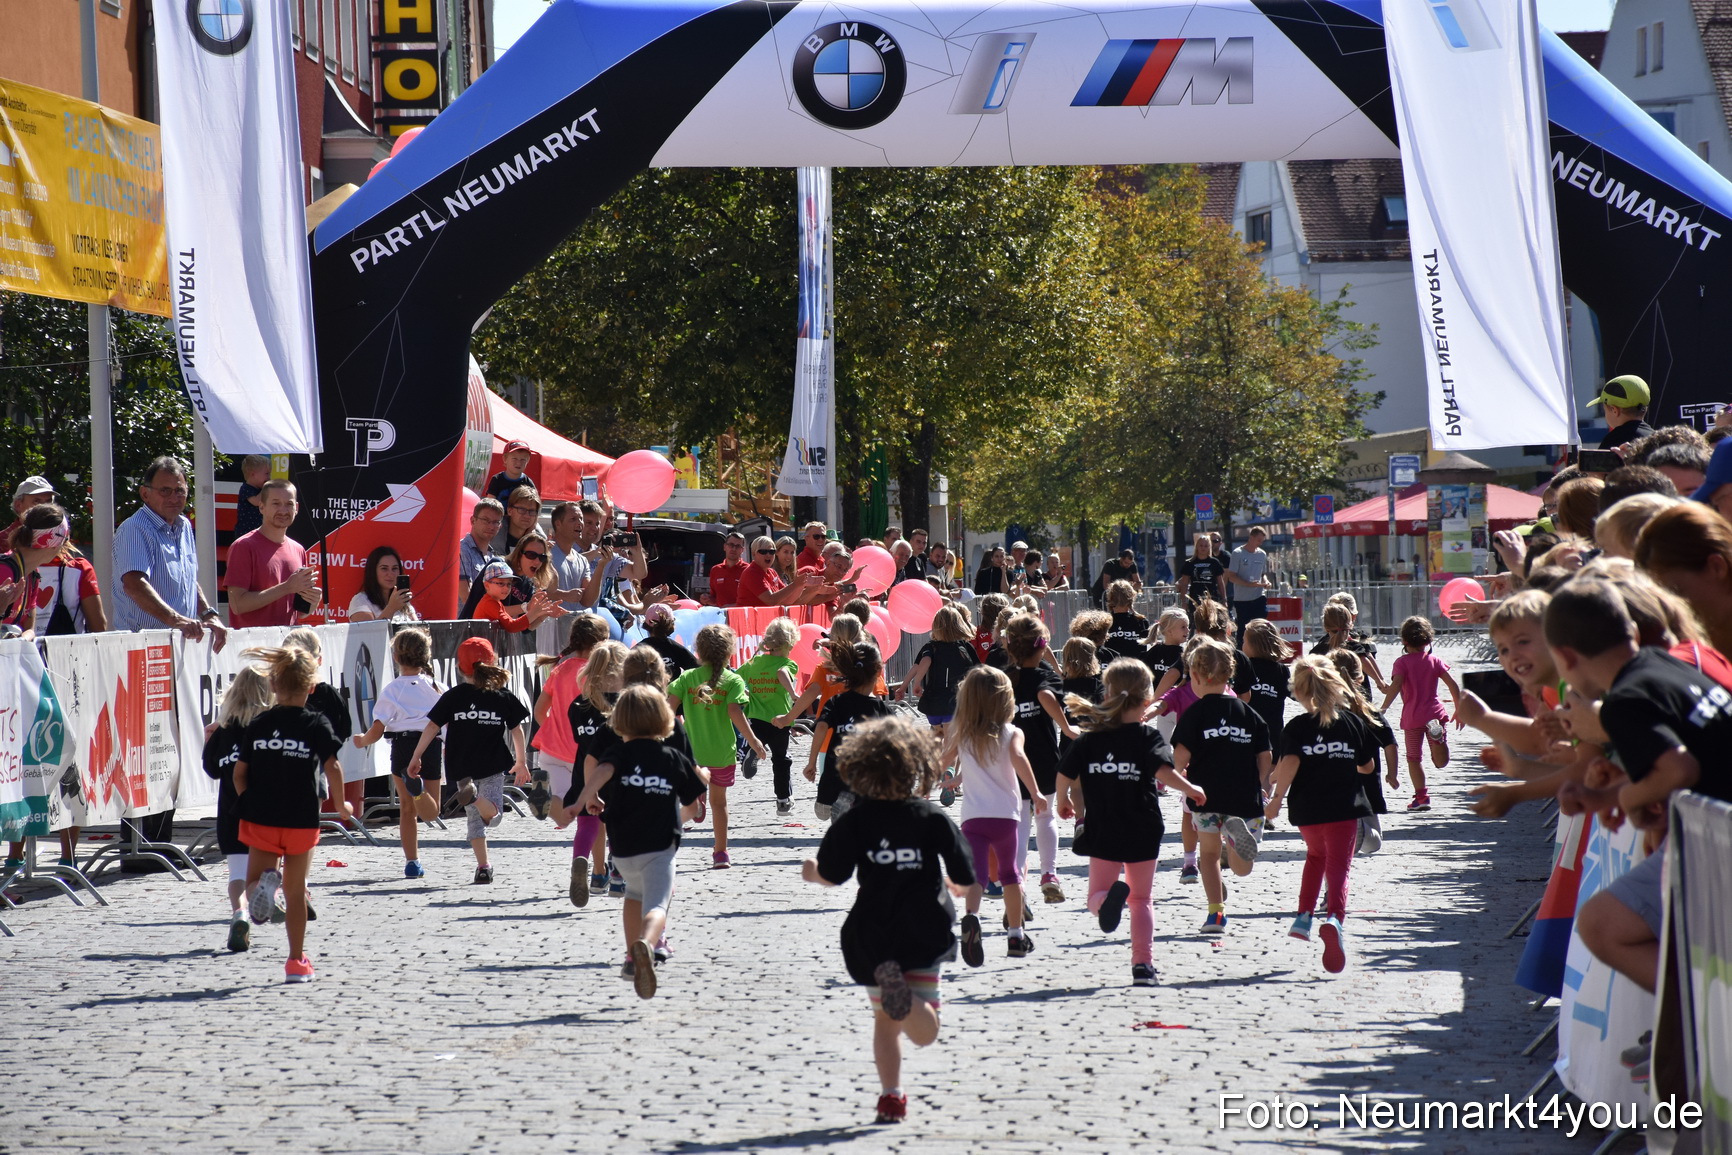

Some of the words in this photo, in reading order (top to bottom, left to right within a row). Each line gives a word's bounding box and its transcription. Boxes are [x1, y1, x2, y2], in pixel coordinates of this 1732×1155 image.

[803, 22, 896, 54] BMW
[350, 209, 446, 274] PARTL
[443, 107, 602, 219] NEUMARKT
[1550, 150, 1722, 252] NEUMARKT
[273, 455, 290, 473] 19
[328, 497, 348, 509] THE
[350, 498, 381, 511] NEXT
[329, 509, 365, 521] YEARS
[1197, 511, 1214, 519] TAXI
[1316, 514, 1332, 522] TAXI
